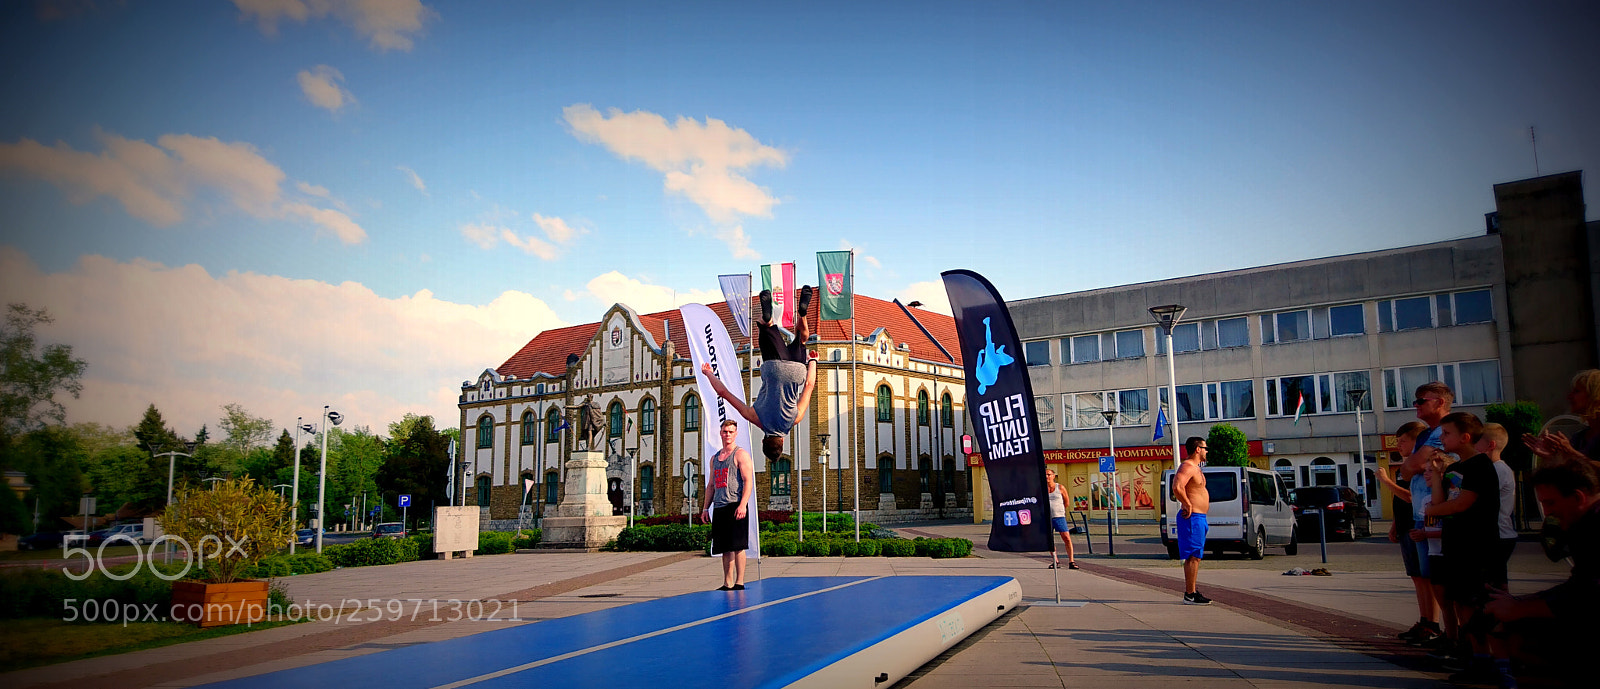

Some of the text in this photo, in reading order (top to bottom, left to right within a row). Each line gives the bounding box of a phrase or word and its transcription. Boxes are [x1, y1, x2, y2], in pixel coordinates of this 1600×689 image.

[1043, 445, 1174, 460] APÍR-ÍRÓSZER NYOMTATVÁN
[400, 496, 409, 506] P
